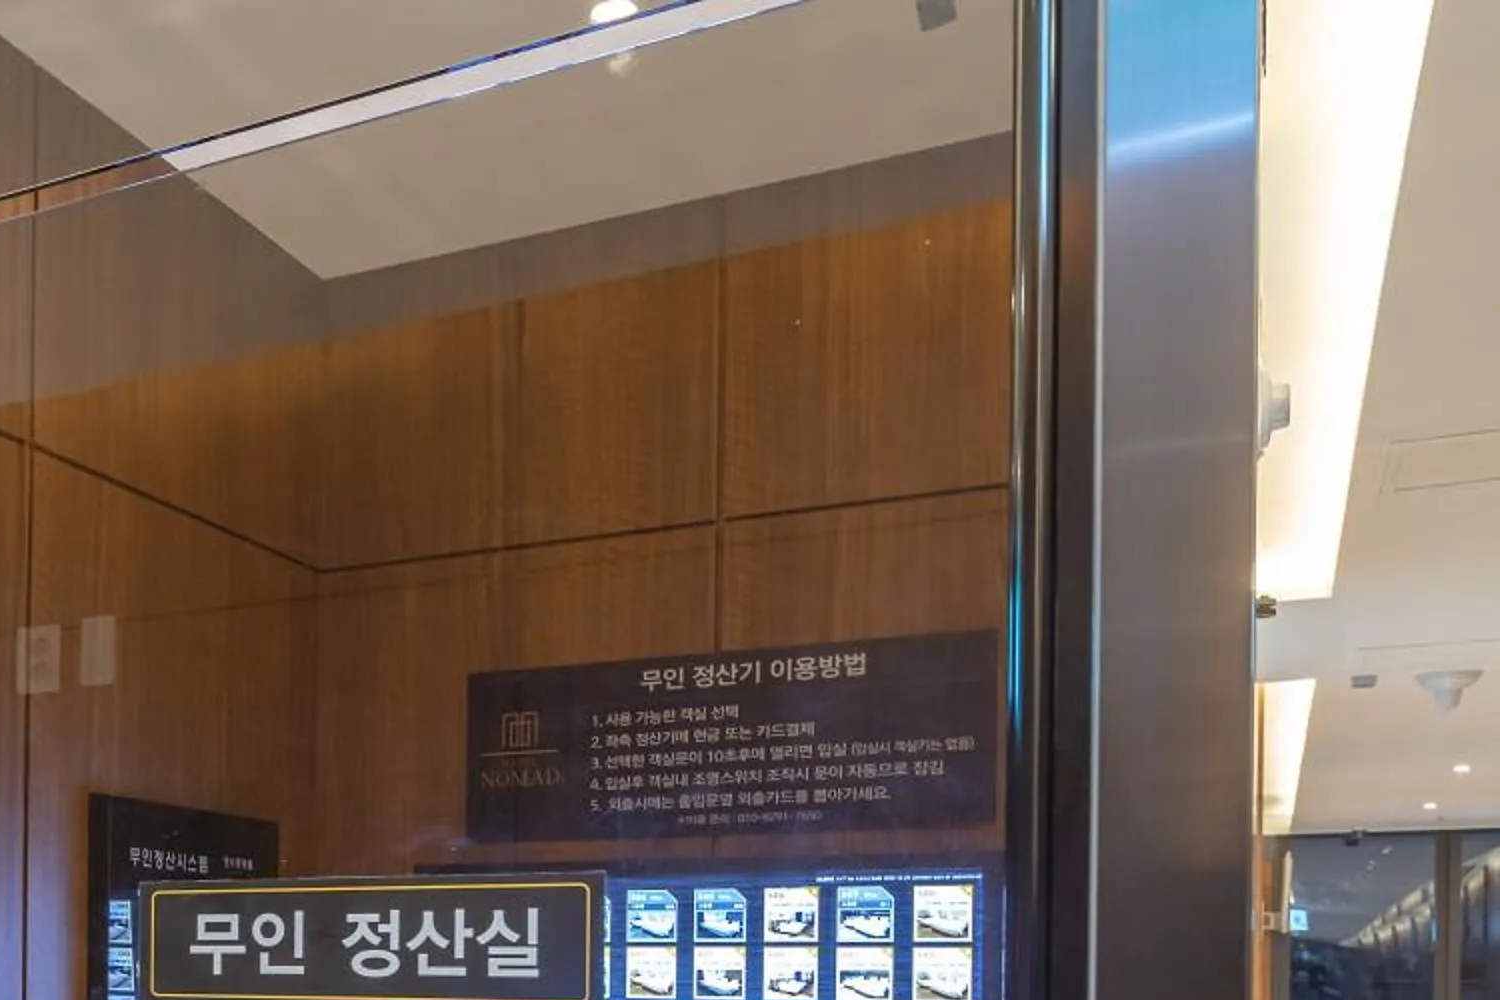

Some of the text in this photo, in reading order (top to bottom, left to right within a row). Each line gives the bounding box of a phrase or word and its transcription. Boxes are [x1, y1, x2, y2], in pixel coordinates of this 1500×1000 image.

[641, 652, 867, 692] 무인 정산기 이용방법
[591, 704, 739, 728] 1. 사용 가능한 객실 선택
[590, 736, 603, 749] 2.
[636, 730, 689, 747] 정산기에
[693, 728, 720, 743] 현금
[724, 726, 753, 741] 또는
[757, 721, 816, 738] 카드결제
[605, 754, 645, 769] 선택한
[648, 751, 703, 767] 객실문이
[770, 744, 812, 761] 열리면
[817, 741, 847, 758] 입실
[848, 761, 909, 779] 자동으로
[129, 847, 210, 875] 무인정산시스템
[189, 907, 540, 978] 무인 정산실
